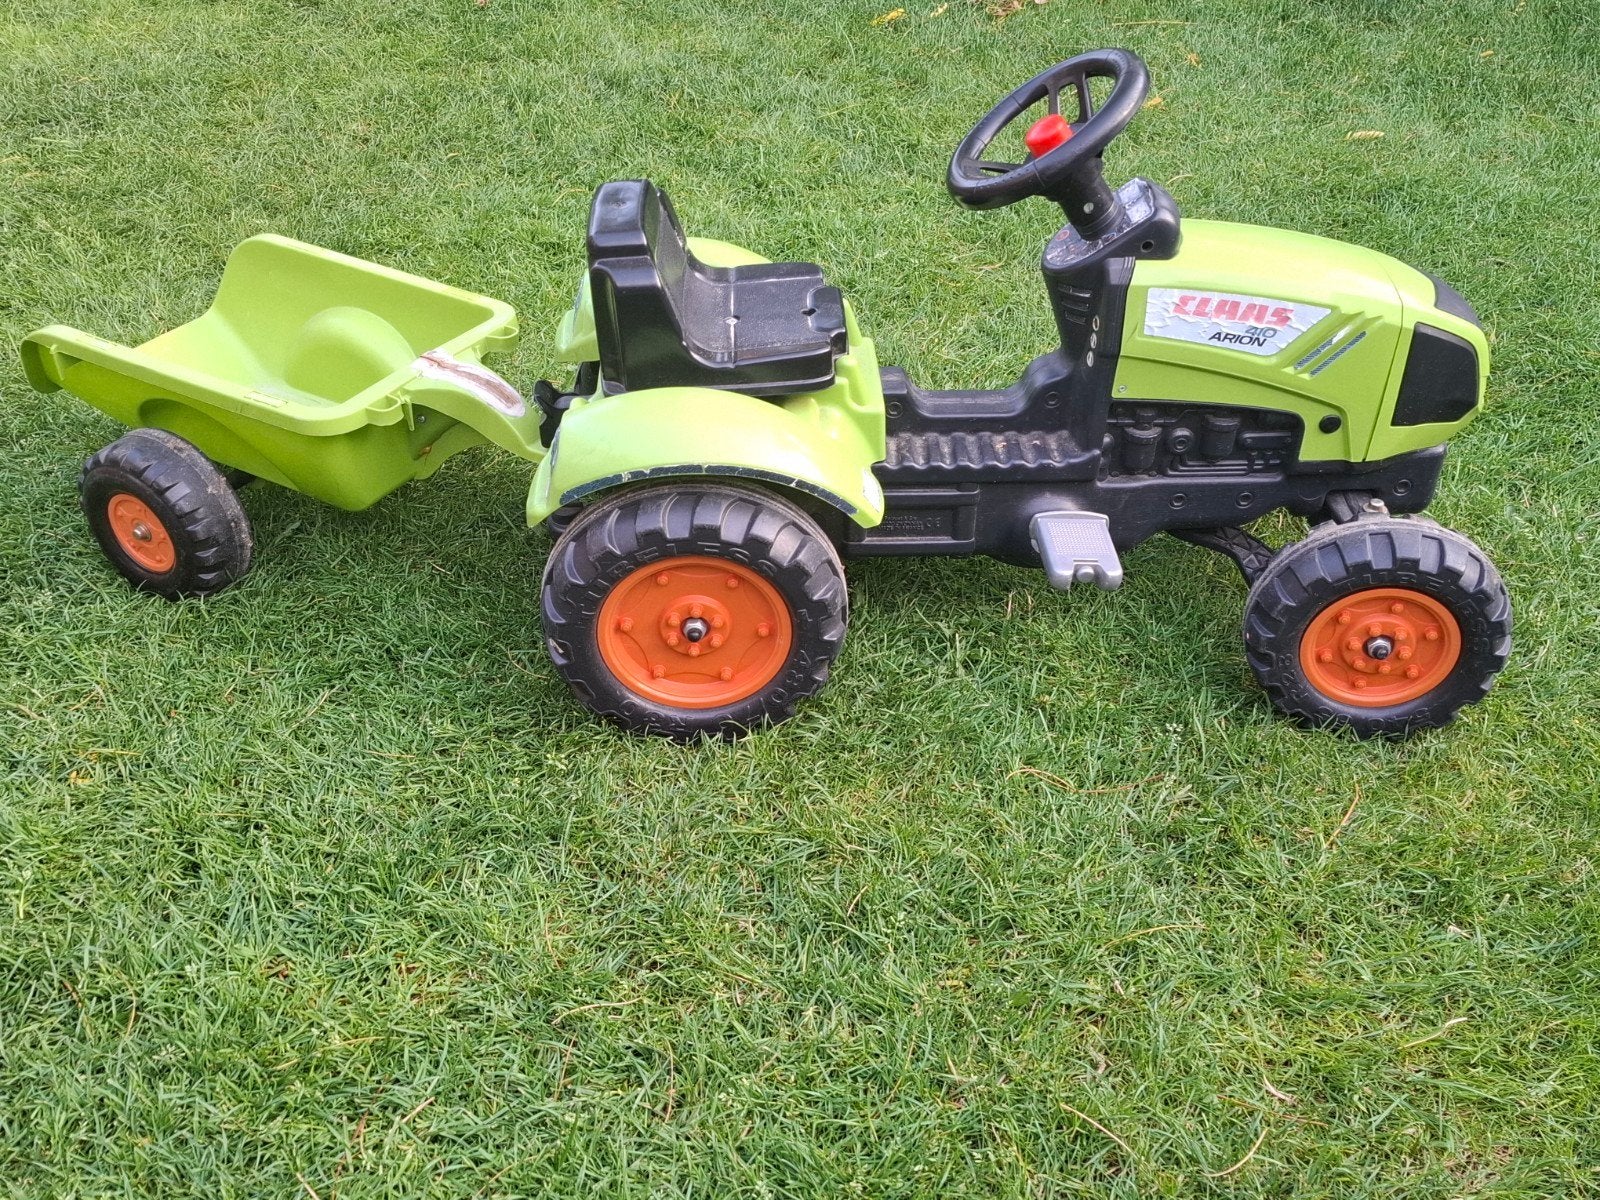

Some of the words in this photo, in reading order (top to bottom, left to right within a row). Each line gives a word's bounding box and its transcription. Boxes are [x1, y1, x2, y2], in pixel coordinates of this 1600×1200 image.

[1172, 295, 1295, 327] CLAAS
[1208, 331, 1267, 348] ARION
[1245, 325, 1277, 339] 410
